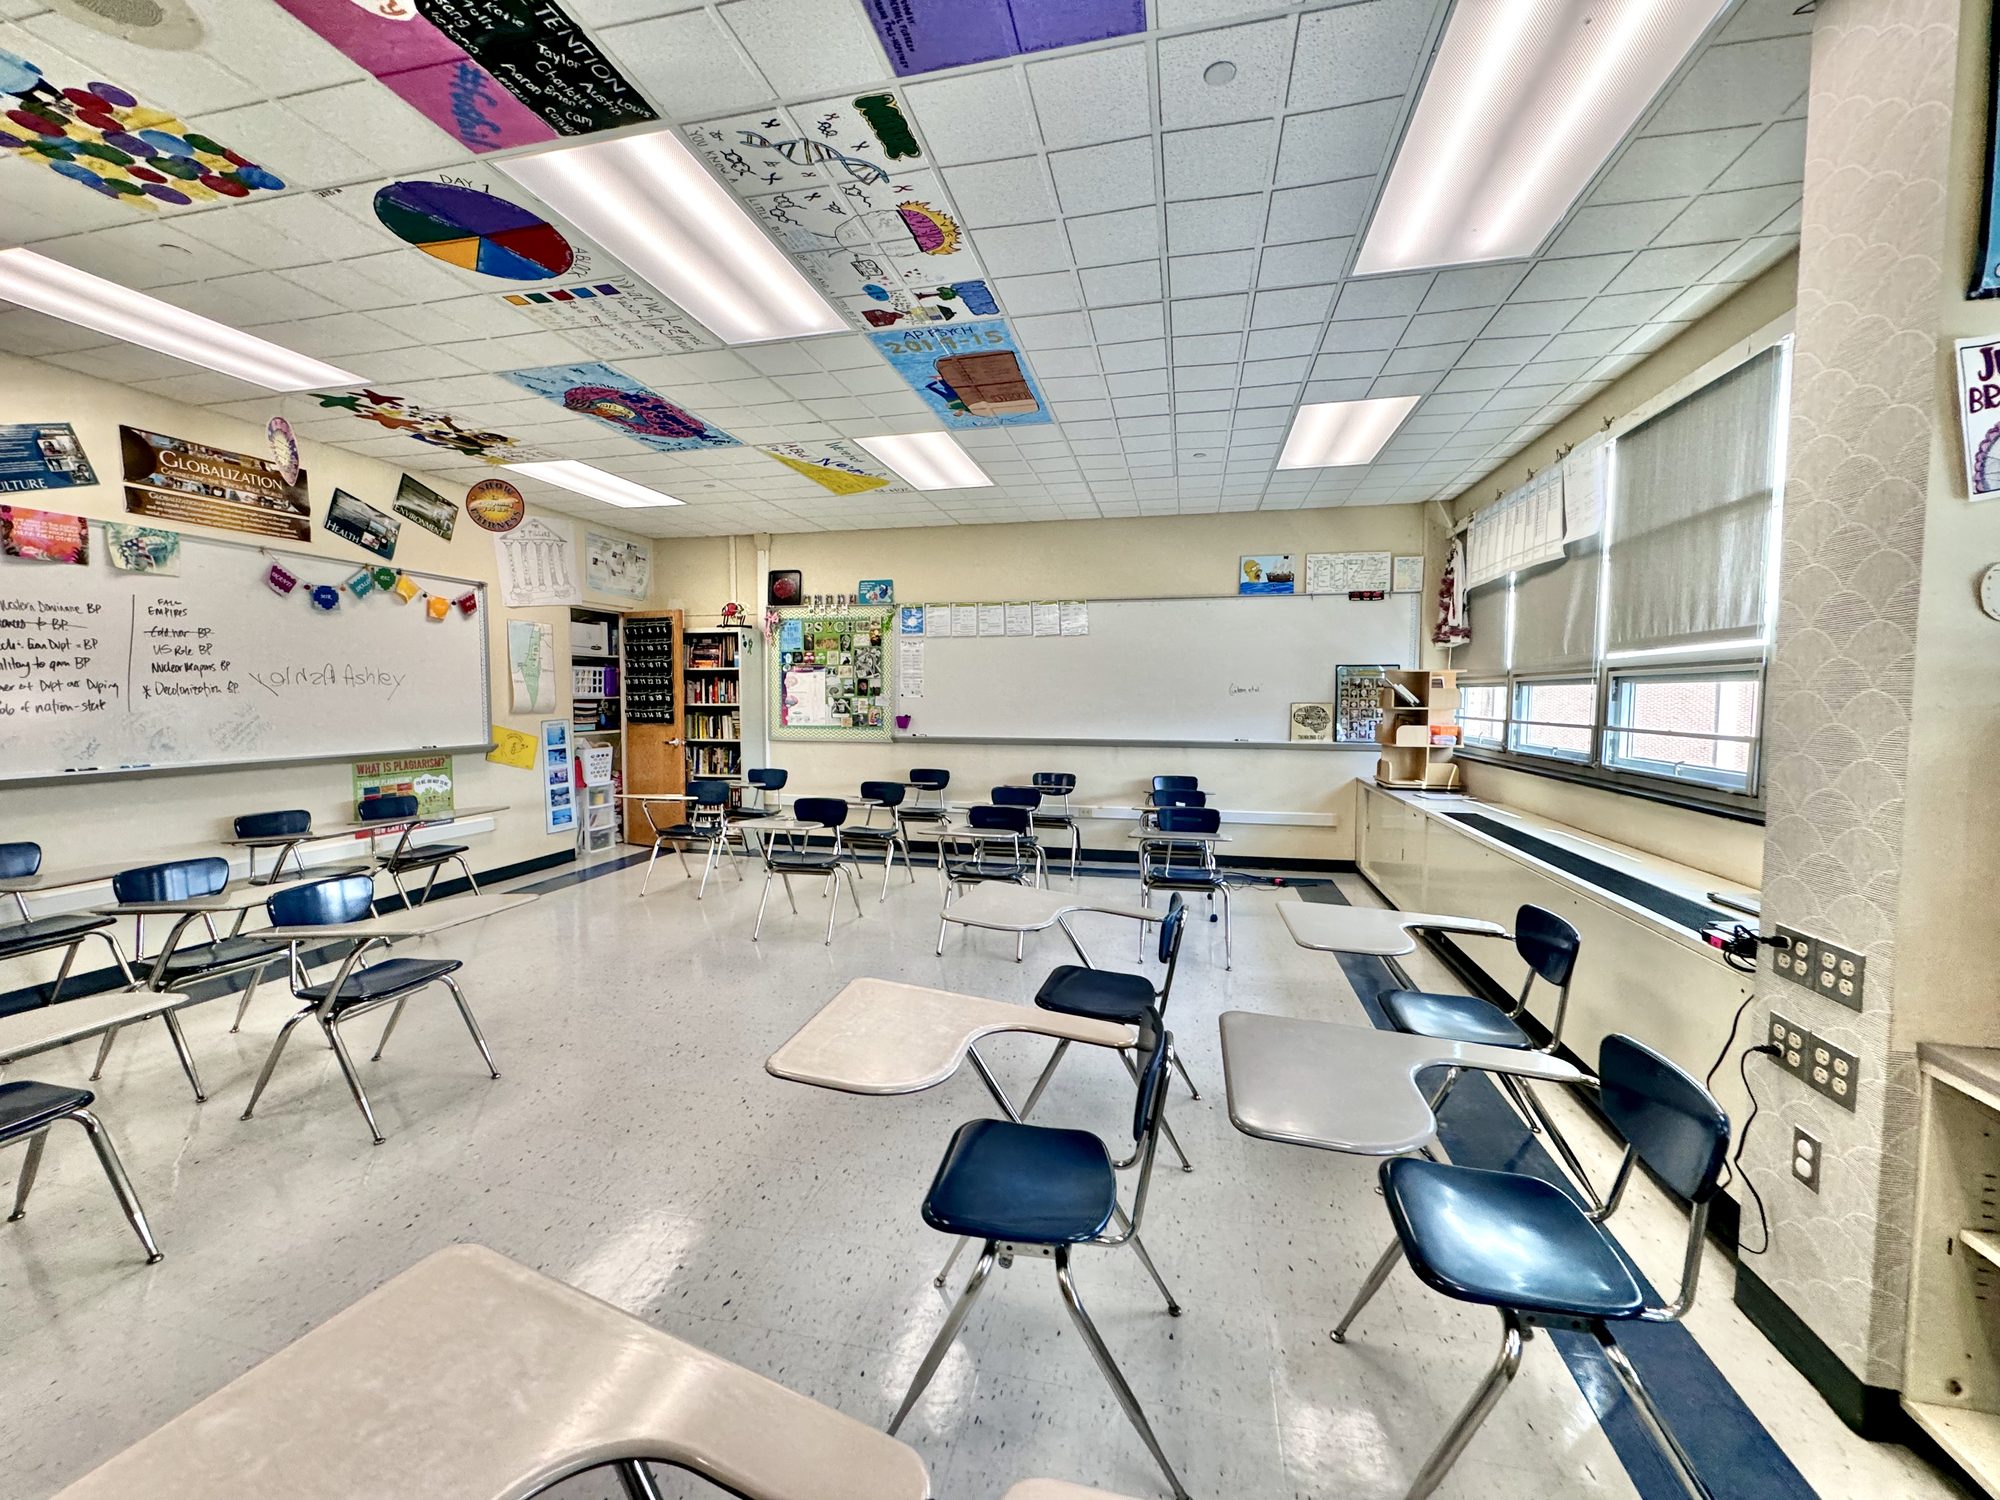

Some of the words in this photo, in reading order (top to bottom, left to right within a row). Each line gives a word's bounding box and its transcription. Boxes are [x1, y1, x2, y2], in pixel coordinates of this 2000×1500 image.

[522, 0, 627, 93] TENTION
[537, 42, 581, 69] Taylor
[535, 61, 593, 110] Charlotte
[579, 82, 623, 116] Austin
[616, 98, 652, 119] Louis
[439, 173, 473, 188] DAY
[704, 150, 731, 175] KNOW
[748, 198, 772, 221] LITTLE
[771, 226, 788, 239] BIT
[903, 330, 924, 340] AP
[159, 450, 284, 491] GLOBALIZATION
[394, 503, 444, 537] ENVIRONMENT
[326, 519, 360, 544] HEALTH
[86, 603, 102, 614] BP
[148, 606, 188, 618] EMPIRES
[197, 627, 212, 639] BP
[804, 621, 855, 634] PSYCH
[83, 638, 98, 650] BP
[153, 644, 172, 655] US
[174, 645, 193, 656] Role
[198, 643, 213, 655] BP
[32, 656, 46, 669] to
[74, 657, 91, 669] BP
[151, 661, 182, 674] Nuclear
[343, 663, 406, 701] Ashley
[35, 698, 107, 715] nation-state
[356, 762, 381, 775] WHAT
[383, 761, 392, 773] IS
[393, 757, 445, 772] PLAGIARISM?
